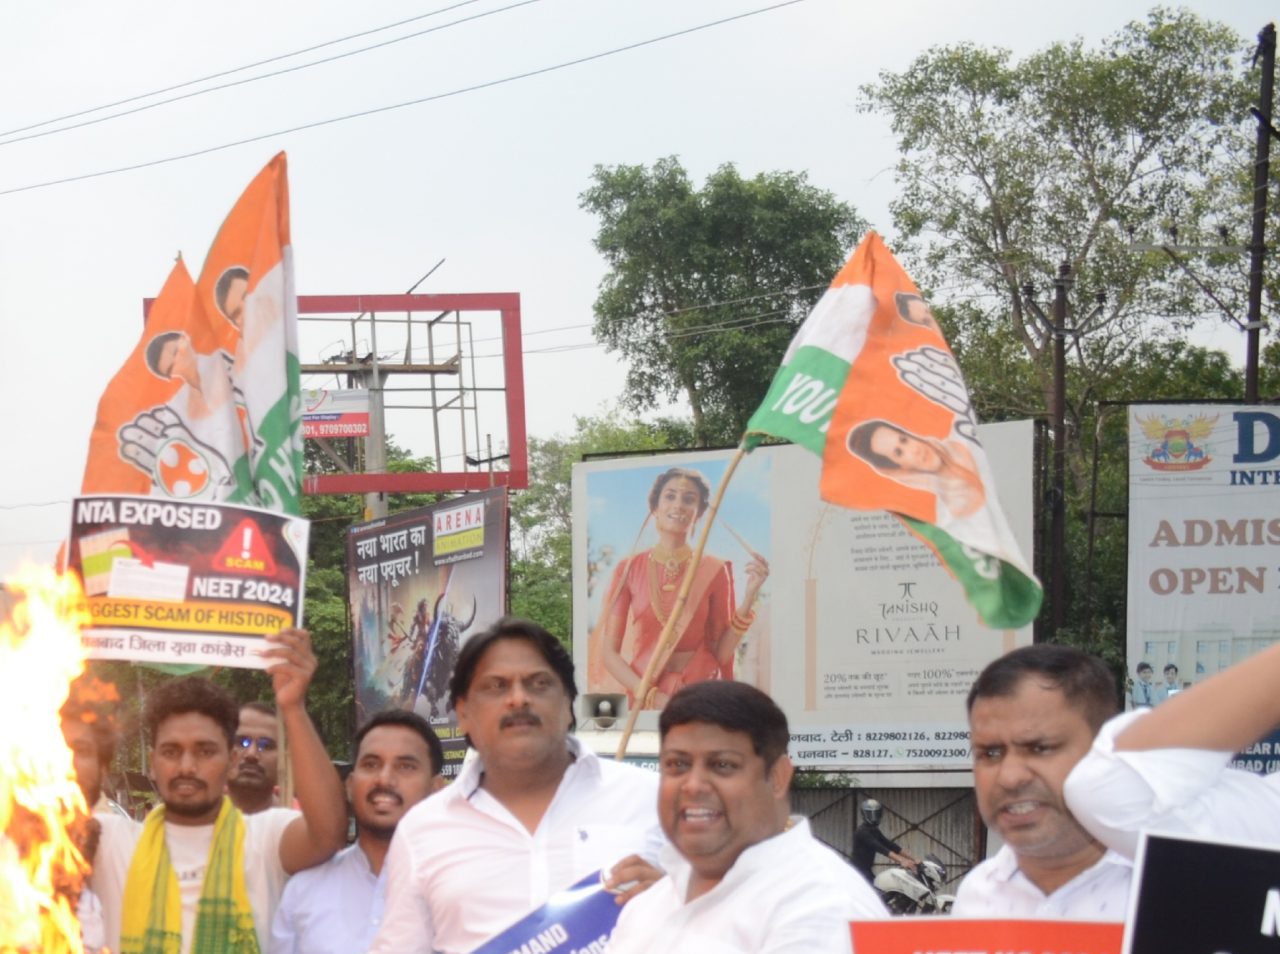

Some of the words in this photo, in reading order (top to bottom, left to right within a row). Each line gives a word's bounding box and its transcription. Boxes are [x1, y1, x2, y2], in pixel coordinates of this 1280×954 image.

[77, 501, 116, 524] NTA
[119, 501, 222, 530] EXPOSED
[436, 507, 482, 532] ARENA
[356, 536, 377, 560] नया
[380, 529, 409, 553] भारत
[410, 526, 426, 546] का
[225, 558, 265, 571] SCAM
[358, 564, 378, 585] नया
[192, 577, 242, 599] NEET
[243, 581, 294, 606] 2024
[1149, 566, 1267, 596] OPEN
[143, 605, 190, 623] SCAM
[194, 609, 215, 624] OF
[218, 610, 286, 630] HISTORY
[129, 635, 166, 652] जिला
[170, 641, 197, 656] युवा
[200, 641, 246, 657] कांग्रेस
[1241, 742, 1271, 755] EAR
